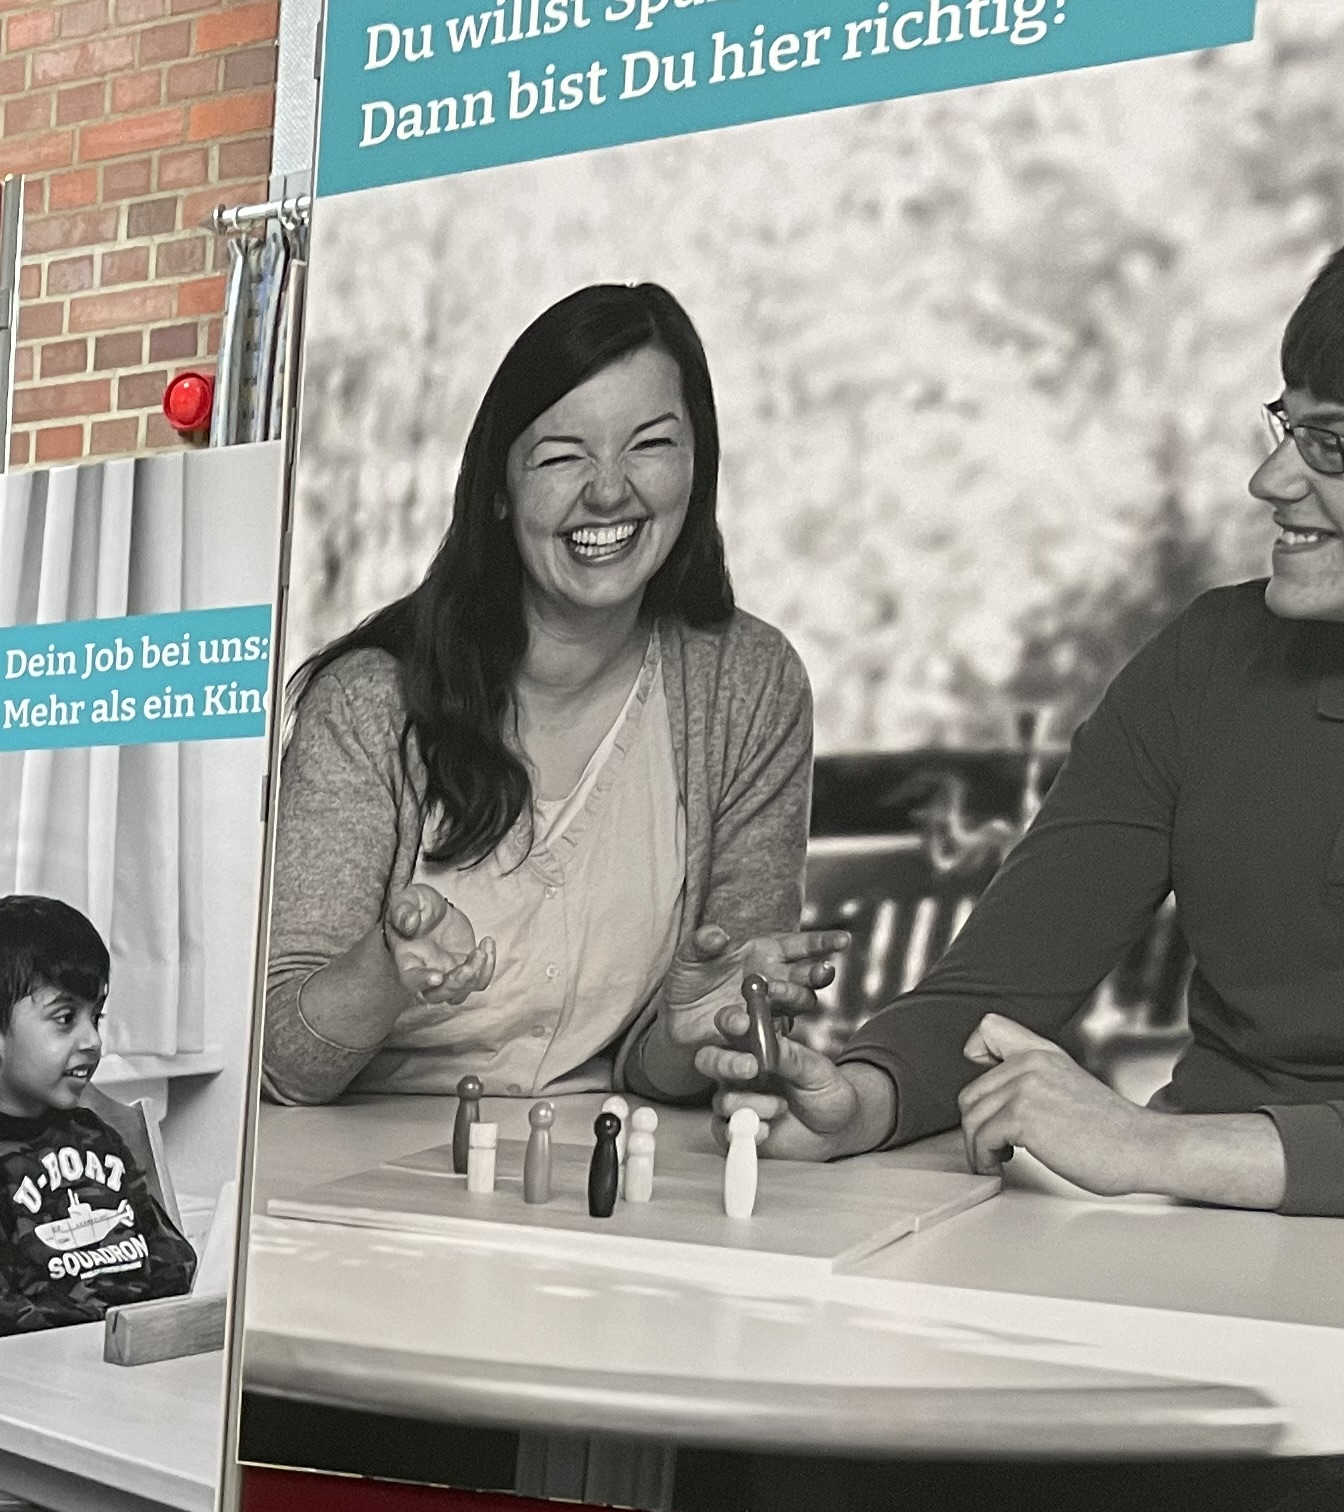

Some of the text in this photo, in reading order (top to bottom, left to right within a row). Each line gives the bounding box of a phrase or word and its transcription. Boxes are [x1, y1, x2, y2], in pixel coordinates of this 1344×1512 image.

[364, 22, 434, 70] Du
[445, 0, 592, 52] willst
[359, 89, 496, 147] Dann
[507, 61, 608, 120] bist
[618, 50, 697, 100] Du
[708, 25, 831, 84] hier
[5, 632, 269, 680] Dein Job bei uns:
[2, 681, 269, 729] Mehr als ein Kin
[48, 1234, 149, 1279] SQUADRON
